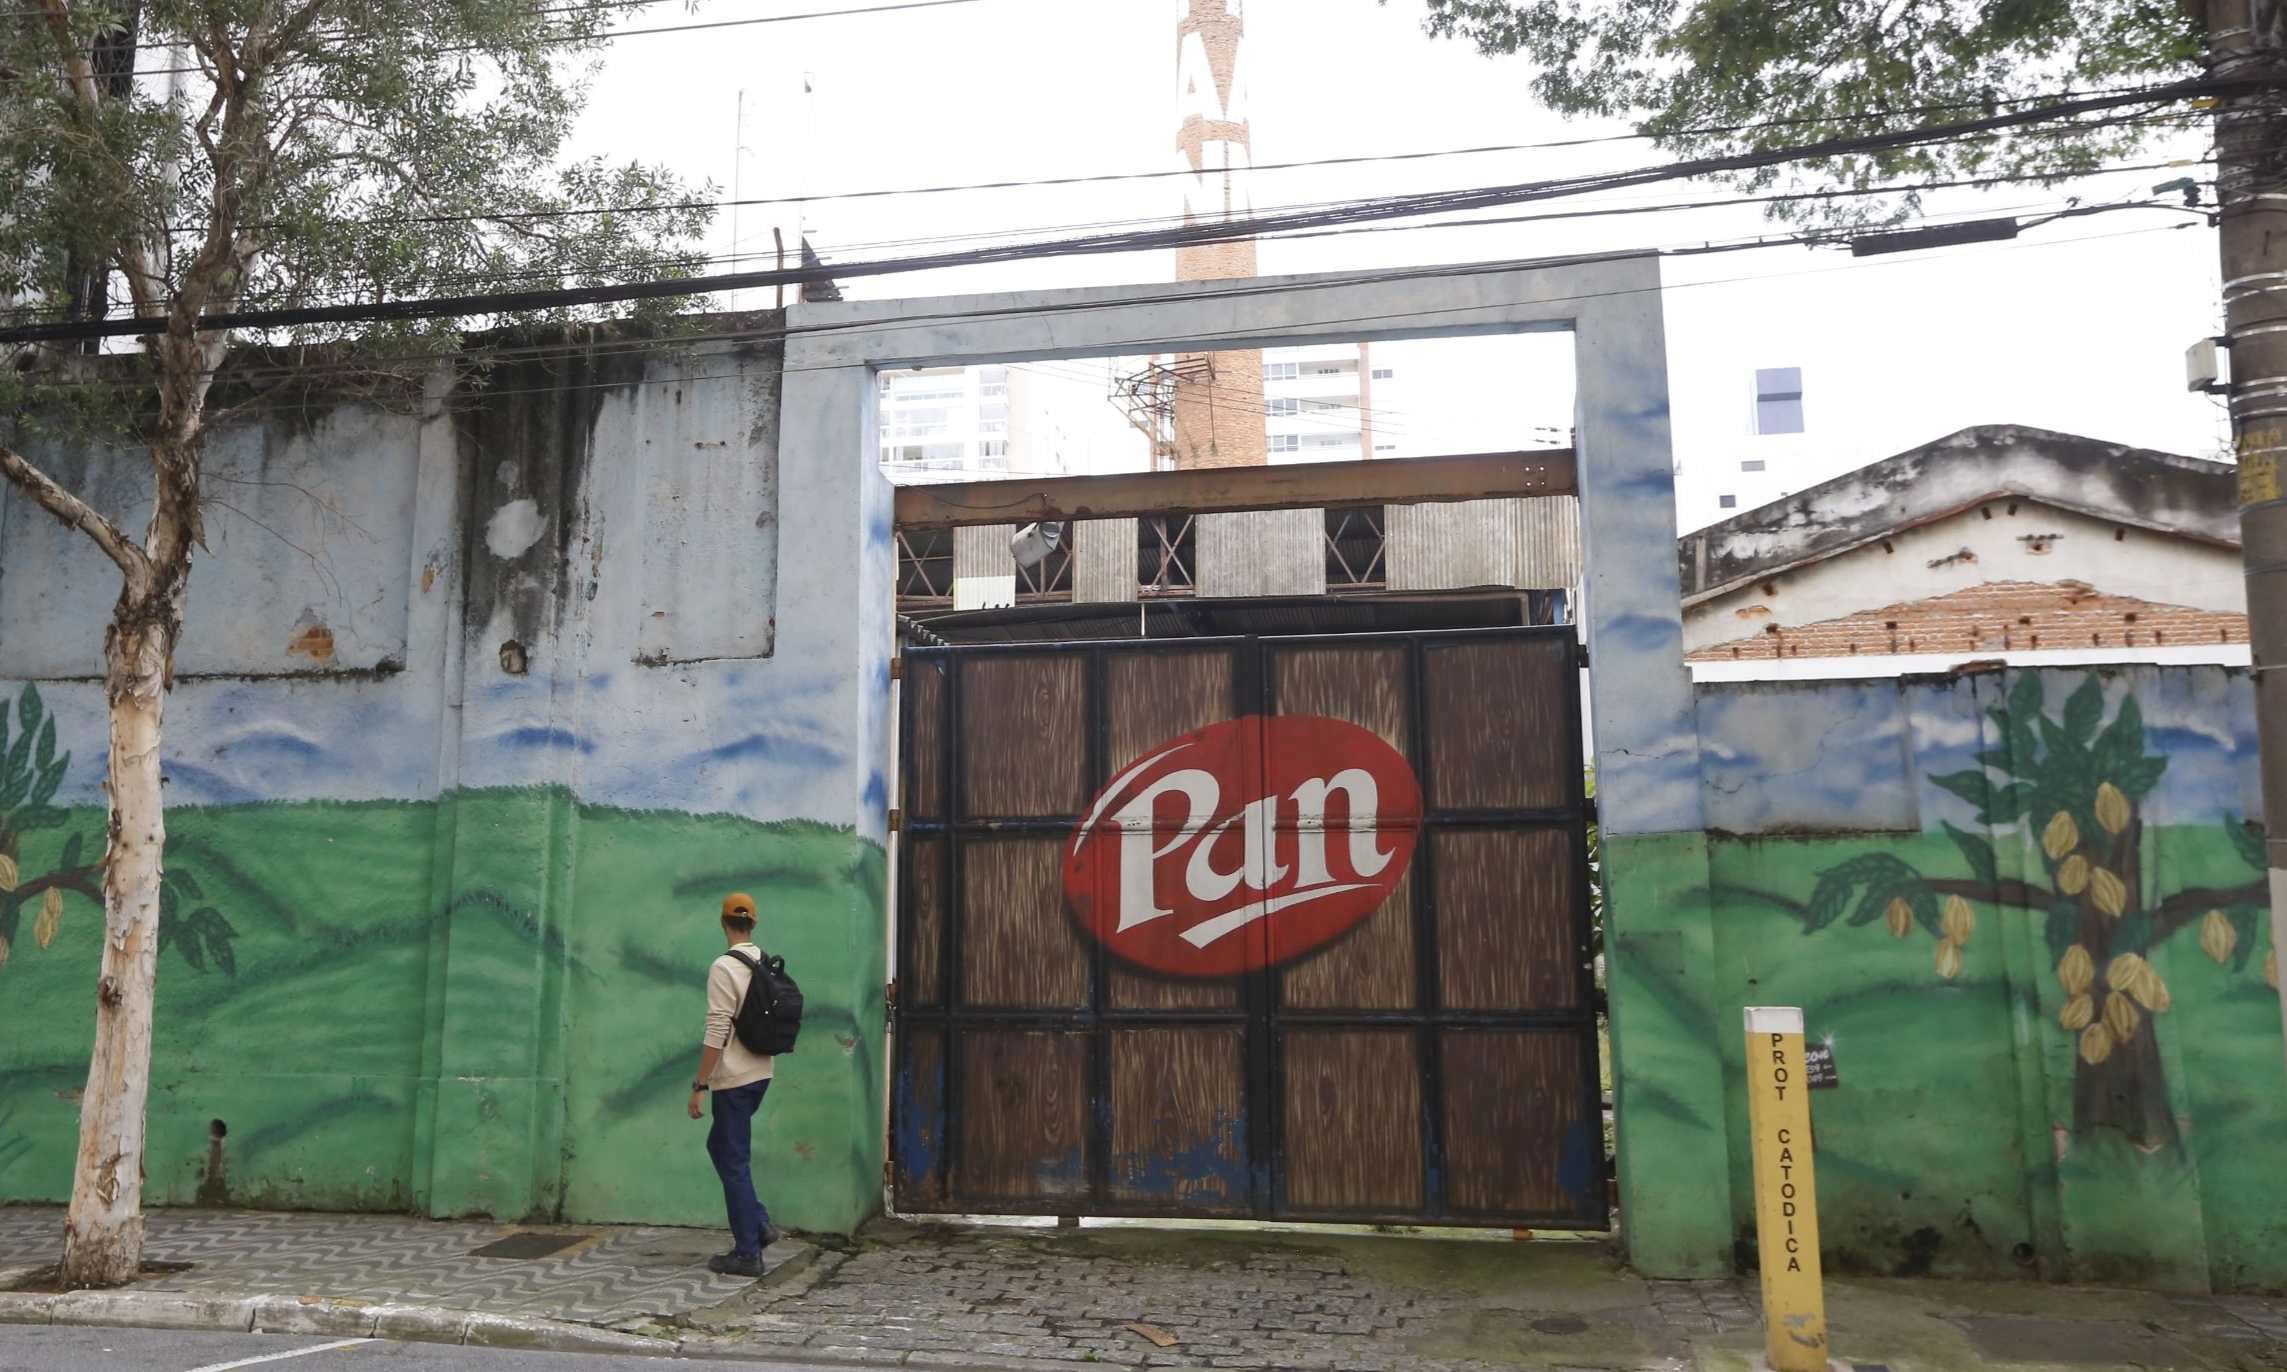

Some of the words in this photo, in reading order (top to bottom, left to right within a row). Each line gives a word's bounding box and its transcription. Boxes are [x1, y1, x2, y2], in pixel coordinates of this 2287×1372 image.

[1110, 767, 1397, 934] Pan
[1770, 1033, 1789, 1101] PROT
[1777, 1129, 1801, 1273] CATODICA
